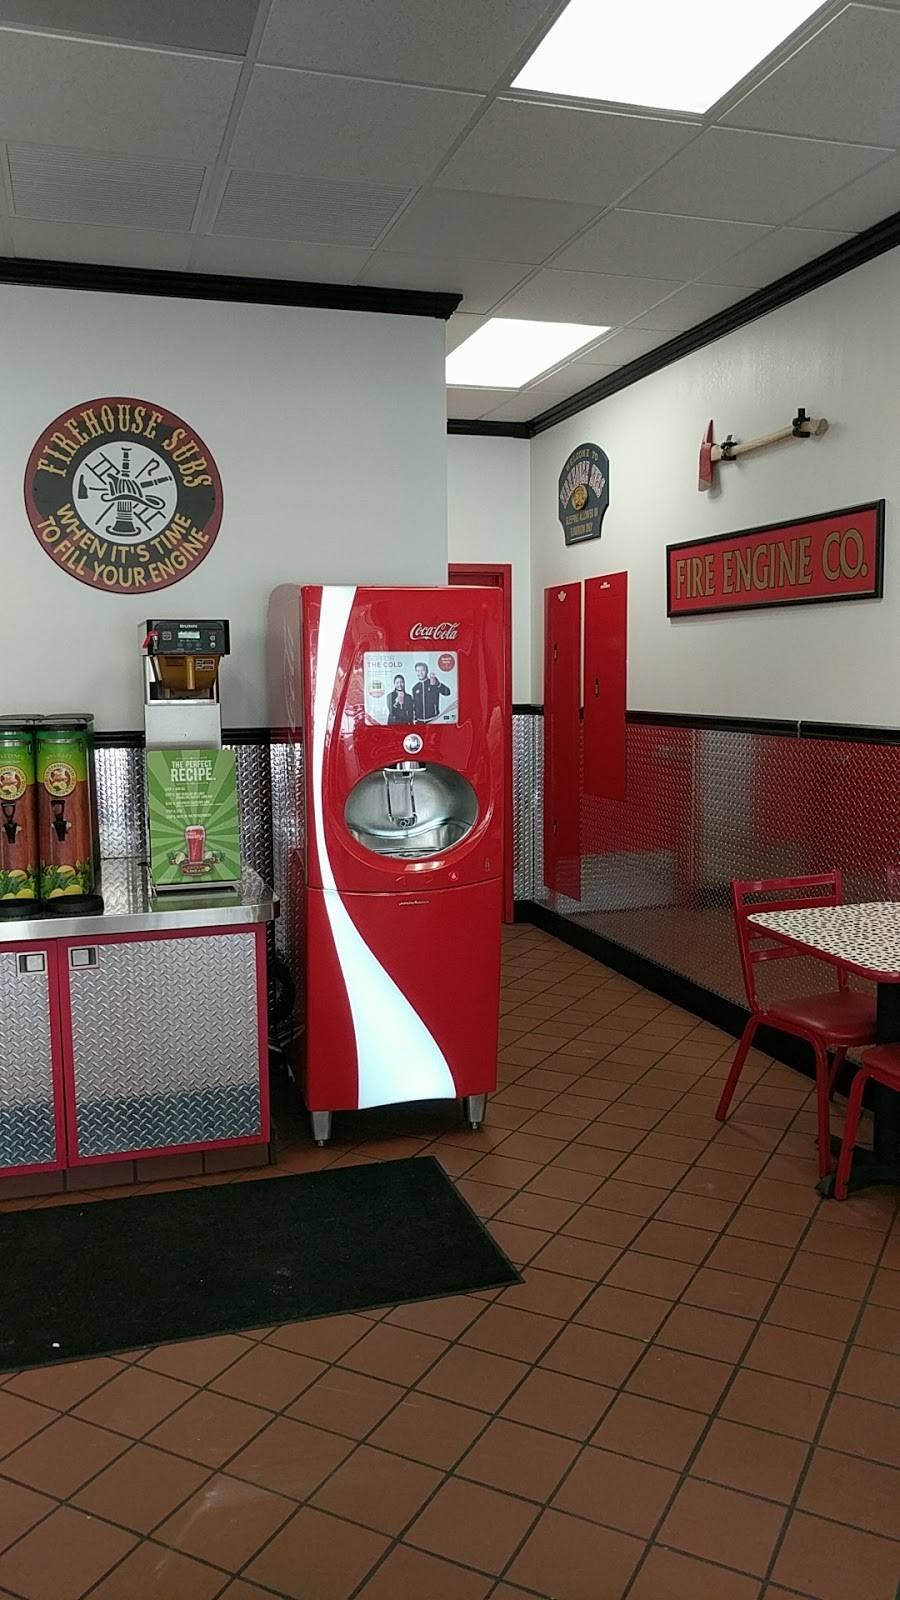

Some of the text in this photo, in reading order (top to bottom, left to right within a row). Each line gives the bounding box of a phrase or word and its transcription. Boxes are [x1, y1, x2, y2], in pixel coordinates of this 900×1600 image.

[37, 404, 213, 488] FIREHOUSE SUBS
[37, 516, 210, 587] TO FILL YOUR ENGINE
[56, 503, 192, 563] WHEN IT'S TIME
[675, 528, 869, 600] FIRE ENGINE CO.
[410, 622, 460, 640] Coca-Cola
[170, 767, 216, 782] RECIPE.
[171, 760, 212, 768] THE PERFECT
